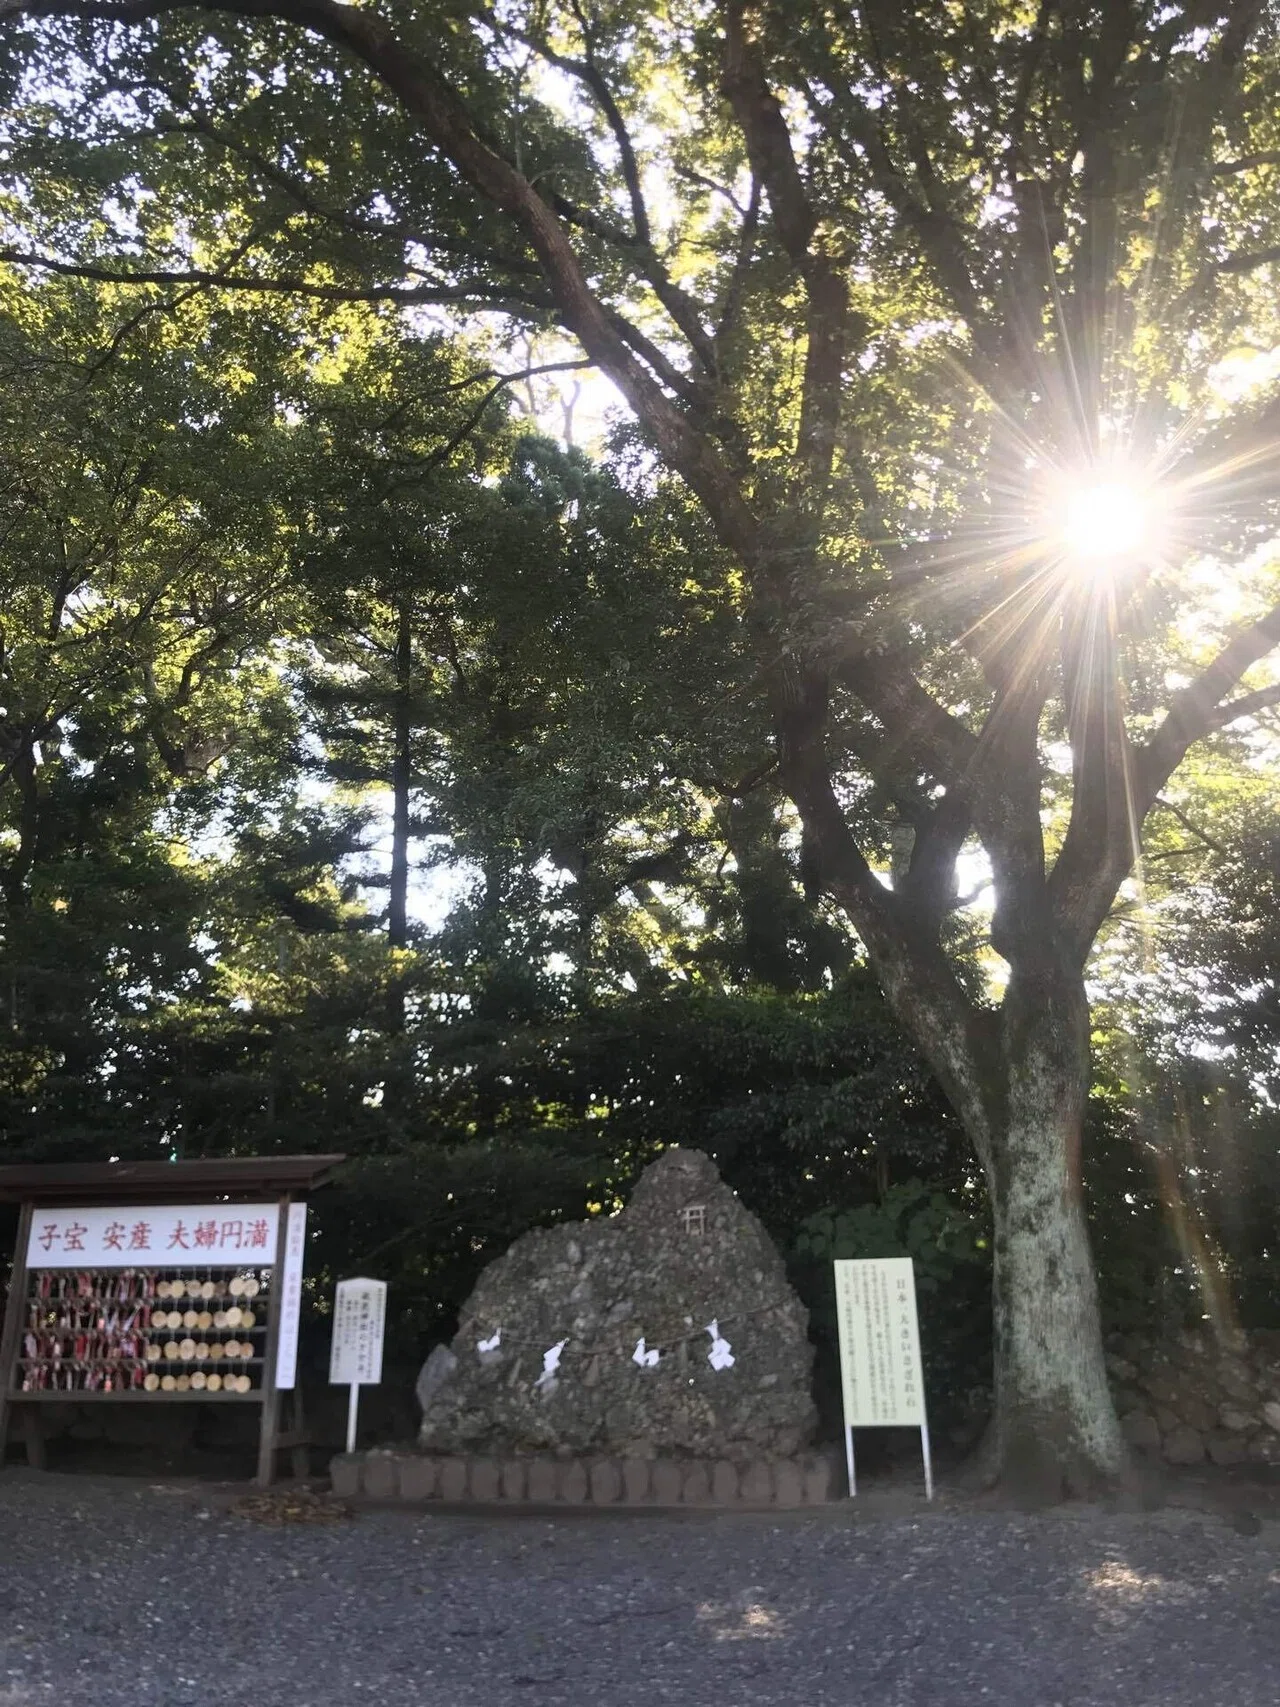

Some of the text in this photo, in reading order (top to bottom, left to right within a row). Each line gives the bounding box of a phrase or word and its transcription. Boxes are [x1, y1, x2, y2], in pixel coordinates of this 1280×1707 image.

[38, 1219, 269, 1251] 子宝 安産 夫婦円満
